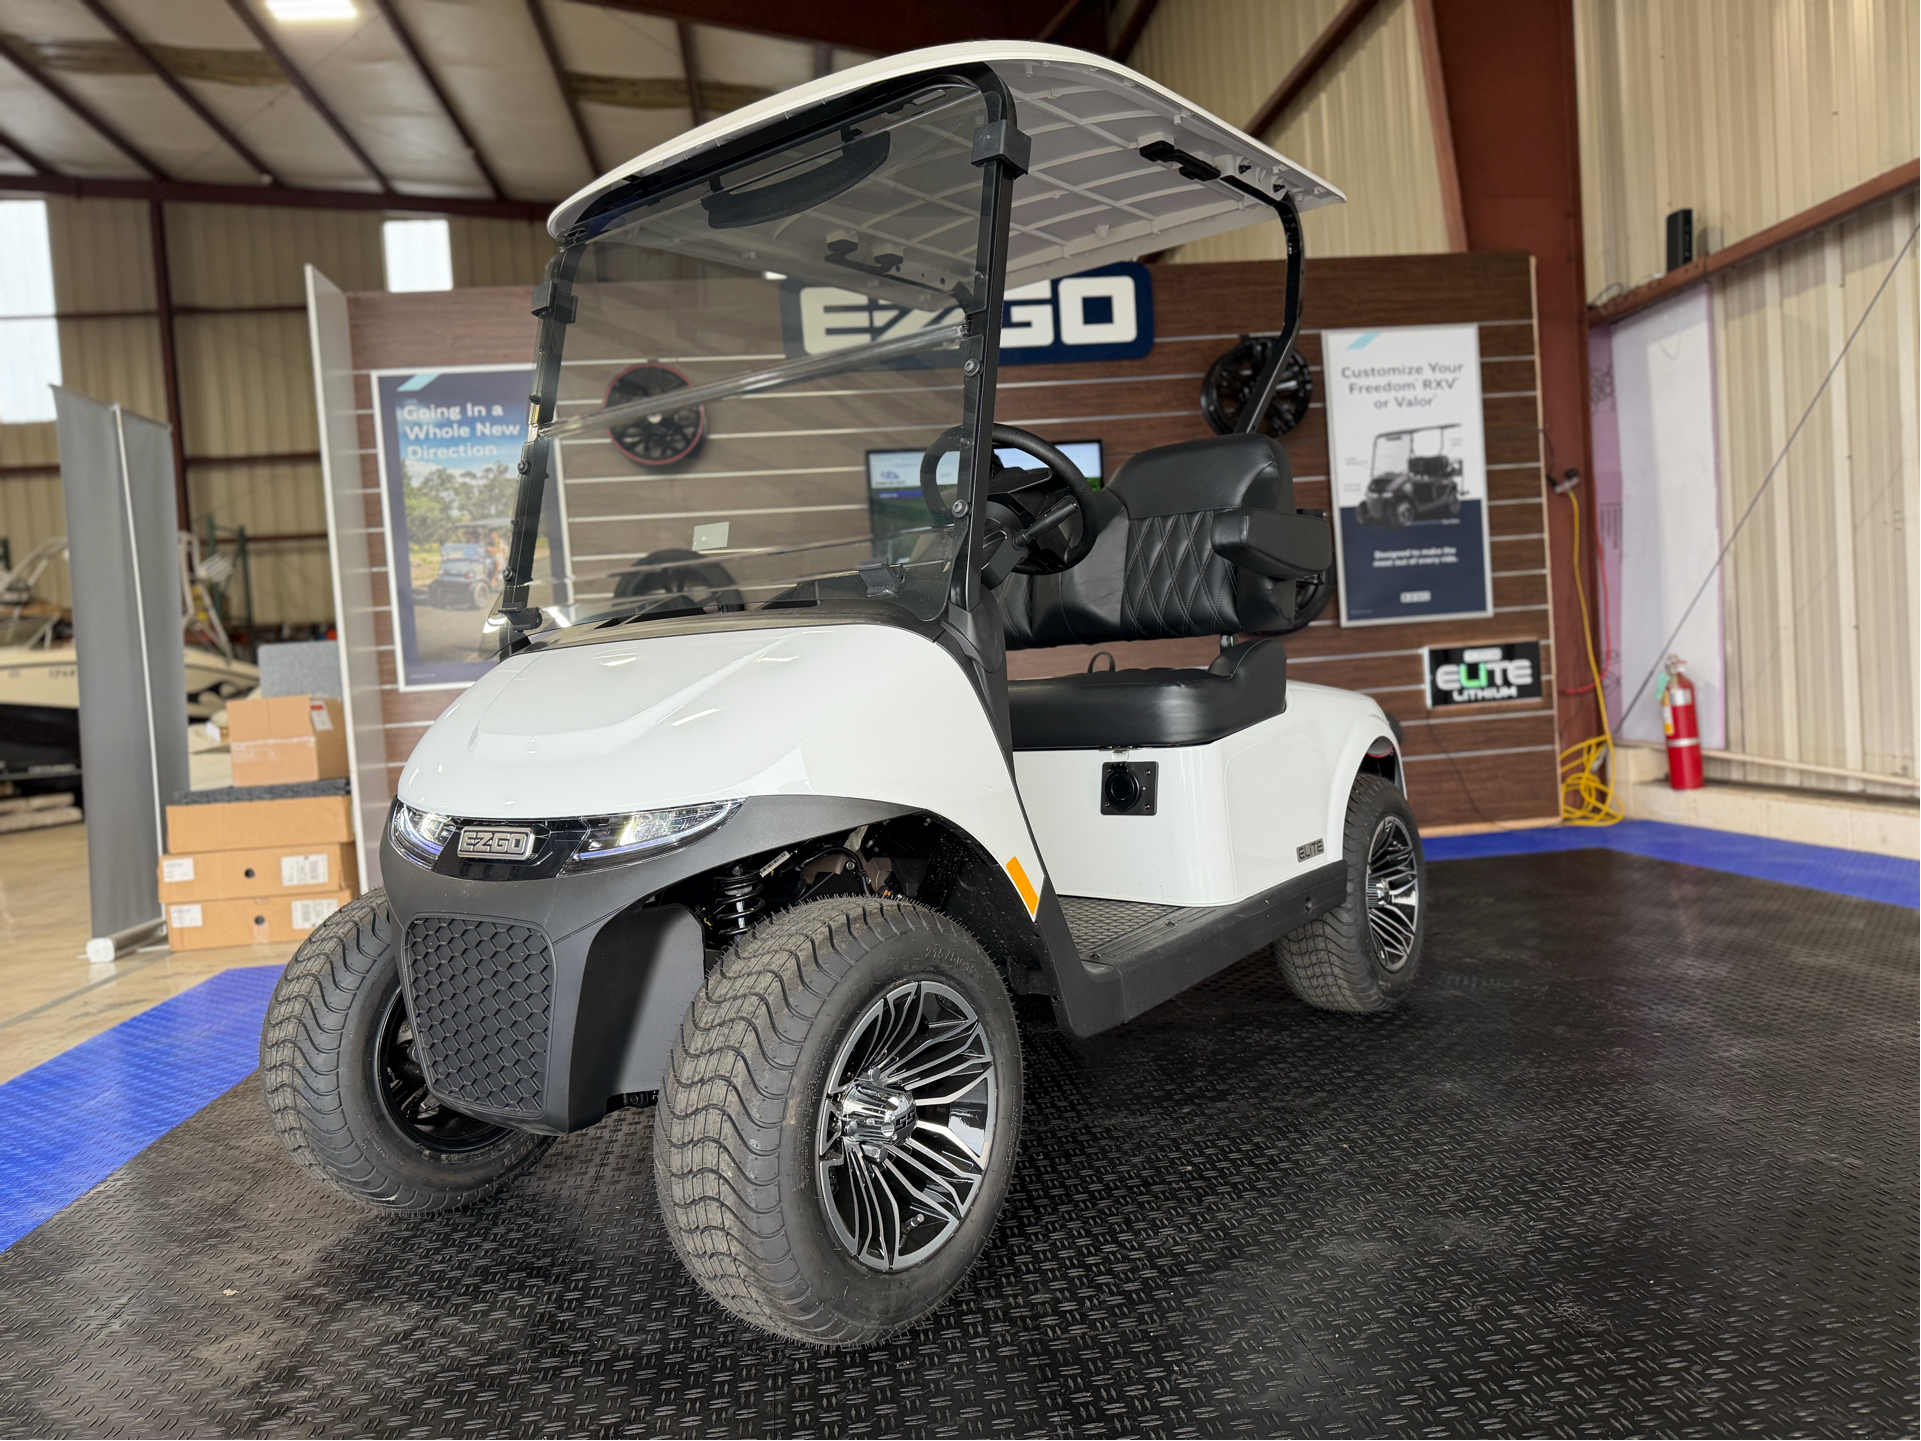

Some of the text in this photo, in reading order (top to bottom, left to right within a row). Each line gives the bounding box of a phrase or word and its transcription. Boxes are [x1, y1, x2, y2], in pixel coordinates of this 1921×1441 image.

[1341, 361, 1464, 379] Customize Your
[402, 402, 504, 421] Going In a
[1373, 399, 1390, 409] or
[404, 421, 521, 440] Whole New
[406, 442, 498, 460] Direction
[1435, 658, 1533, 691] ELITE
[1452, 685, 1518, 702] LITHIUM
[460, 831, 527, 854] EZGO
[1298, 840, 1323, 860] ELITE
